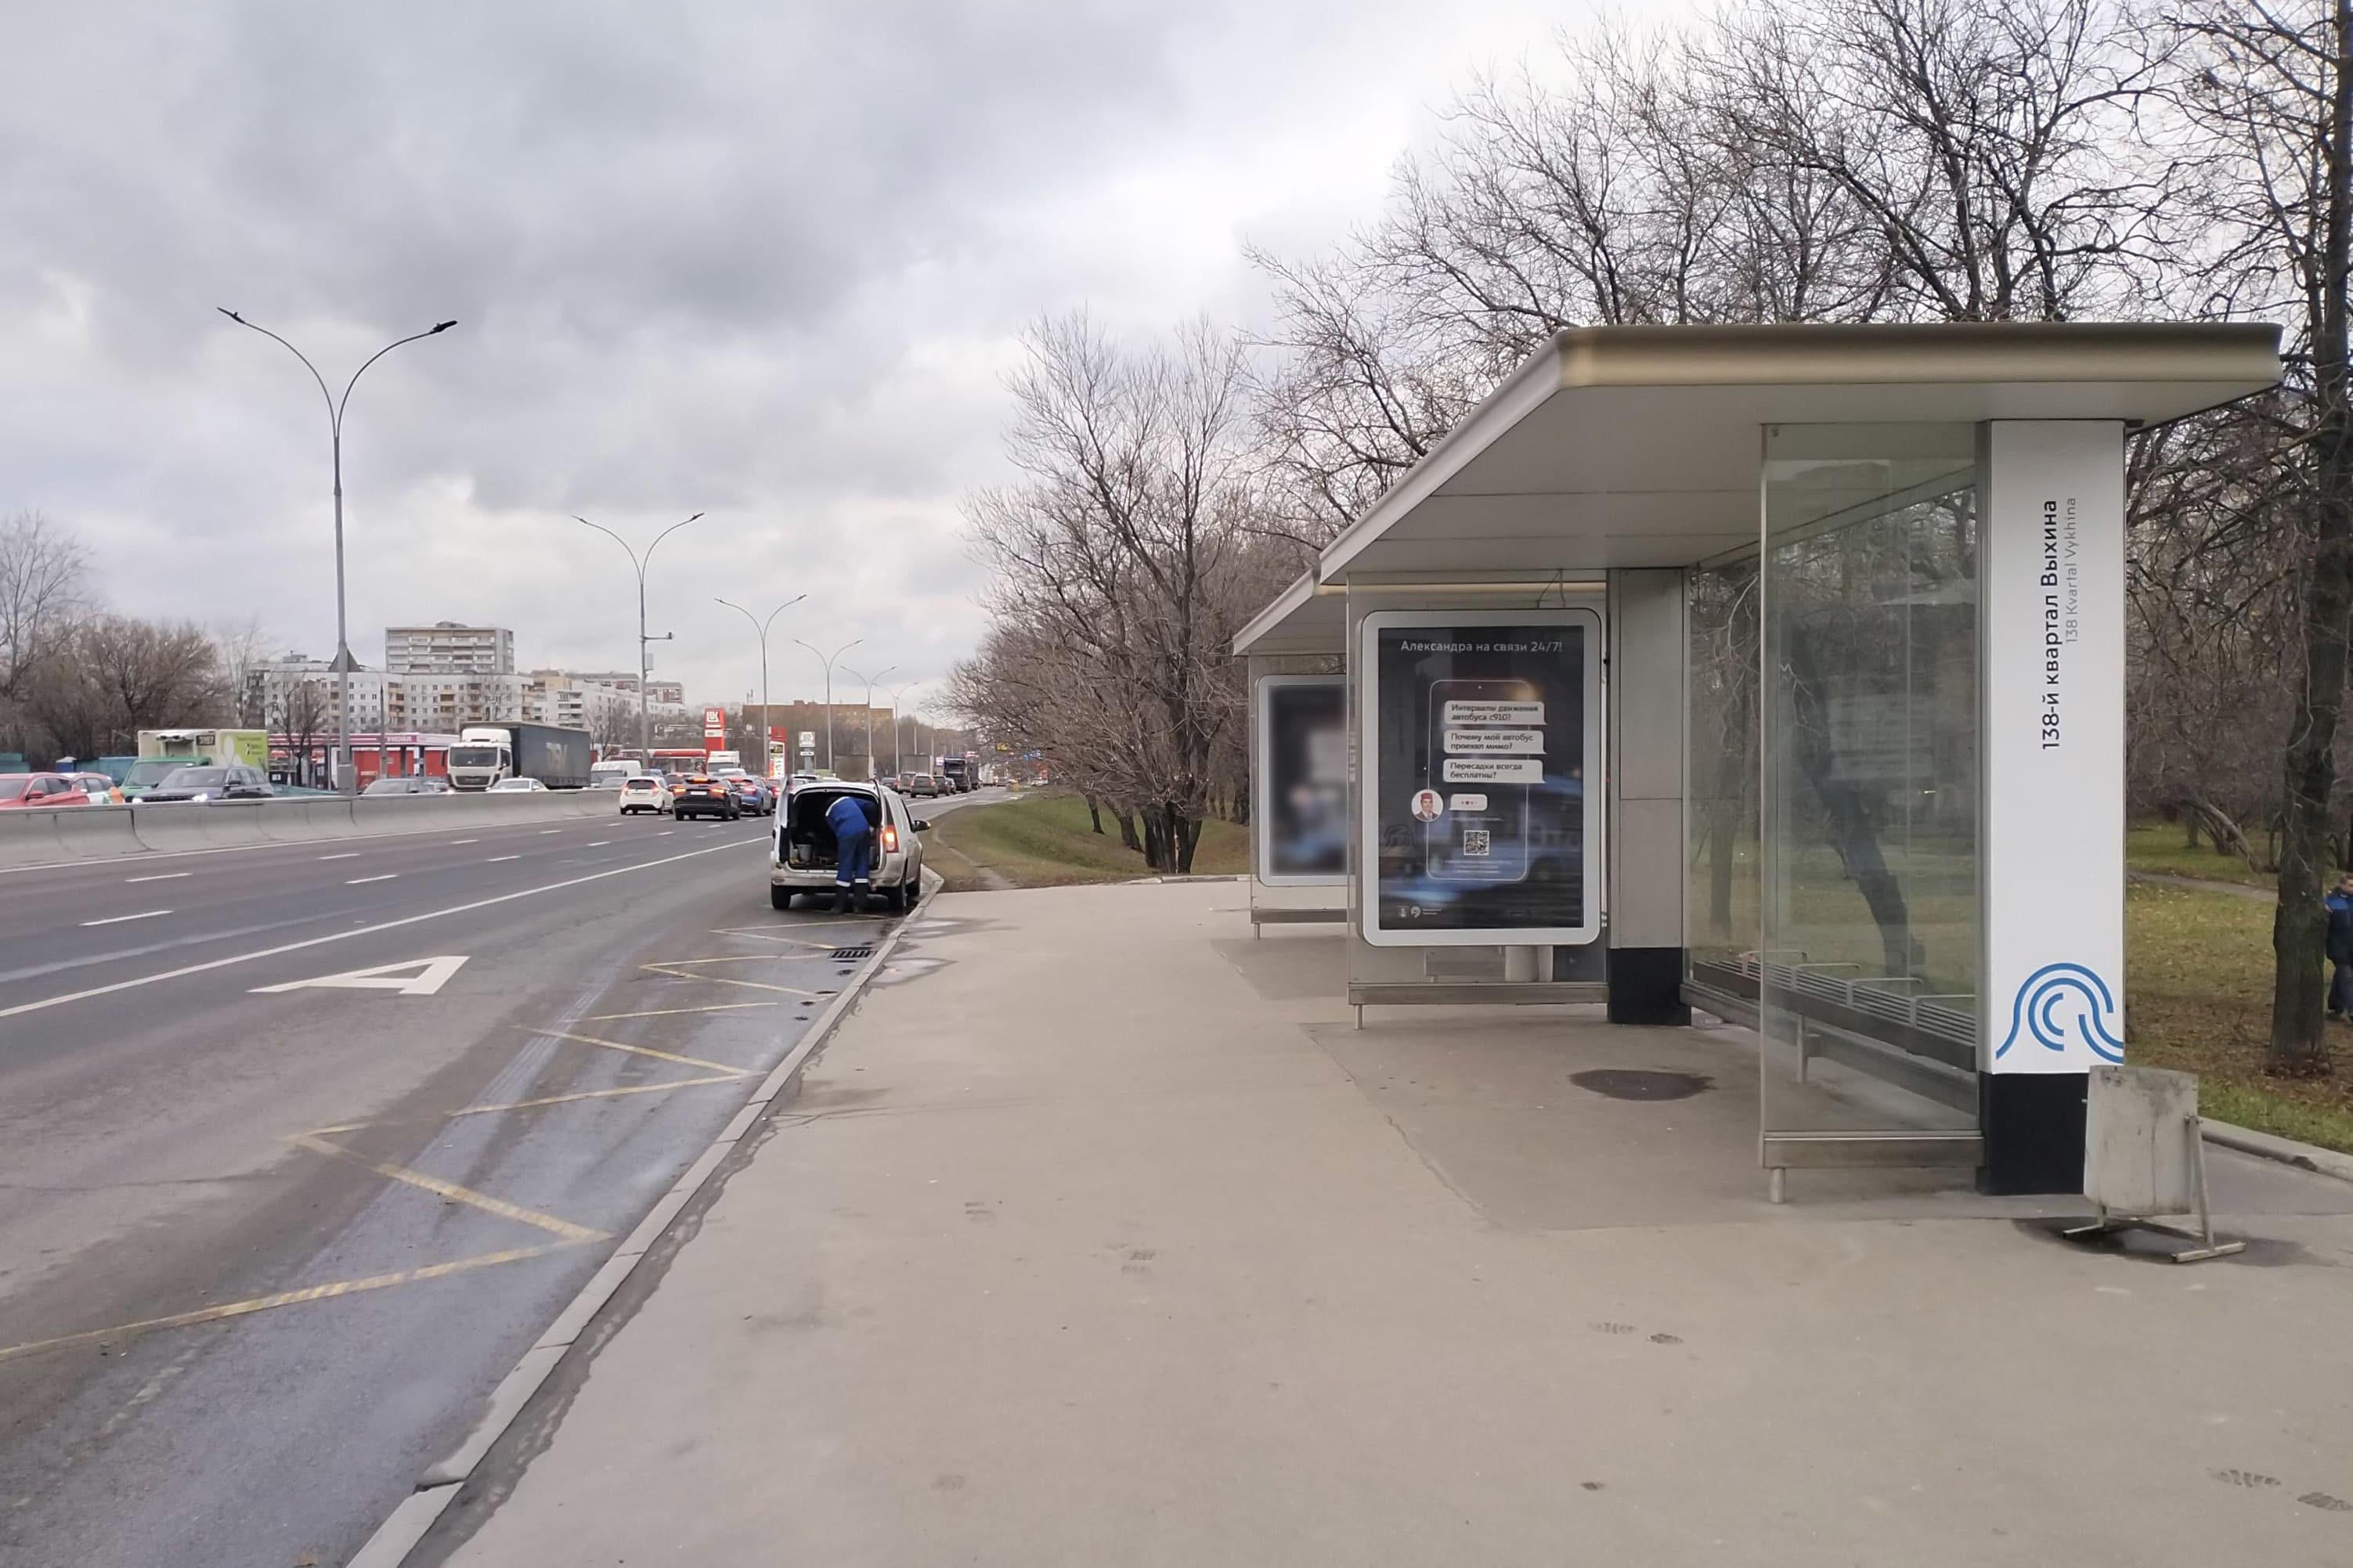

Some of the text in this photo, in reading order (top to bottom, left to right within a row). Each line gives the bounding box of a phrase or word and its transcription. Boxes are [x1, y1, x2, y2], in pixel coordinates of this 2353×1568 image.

[2064, 497, 2080, 643] 138 Kvartal Vykhina
[2040, 499, 2062, 750] 138-й квартал Выхина
[1401, 640, 1563, 652] Александра на связи 24/7!
[1451, 704, 1497, 712] Интервалы
[1451, 712, 1488, 722] автобуса
[1450, 733, 1482, 741] Почему
[1502, 733, 1533, 742] автобус
[1450, 762, 1494, 770] Пересадки
